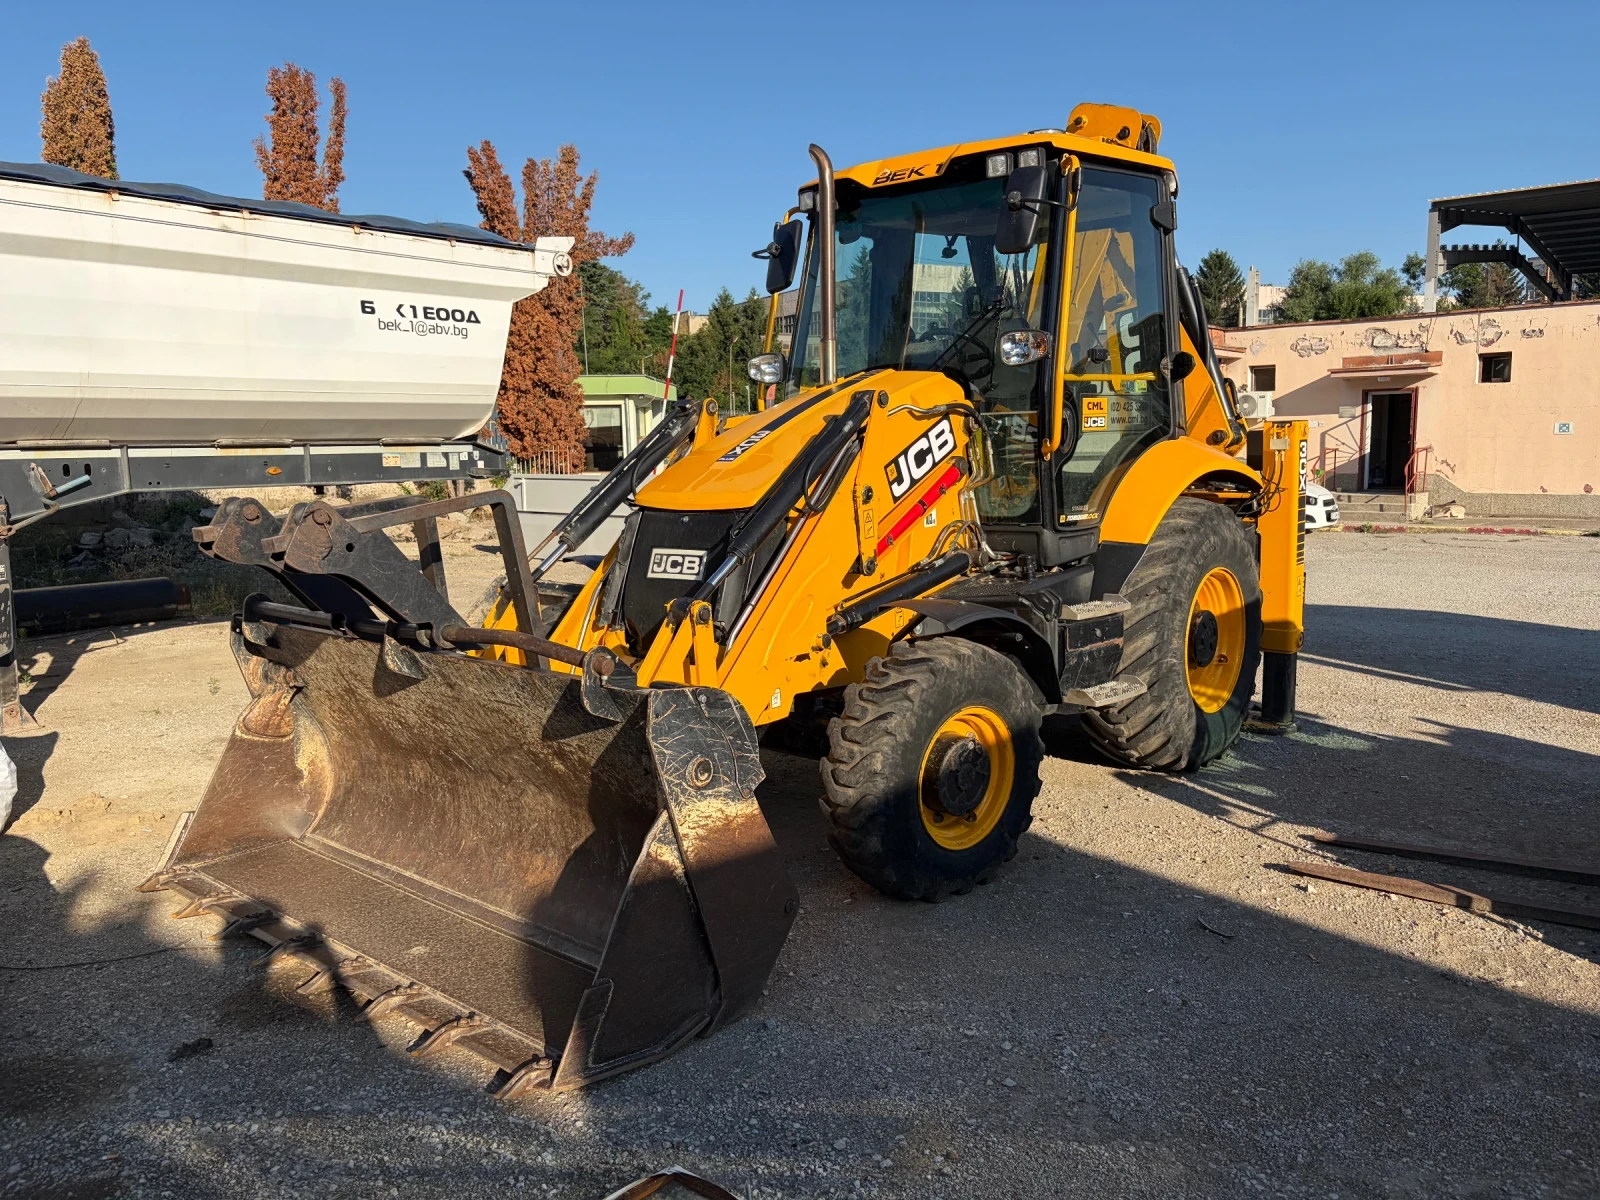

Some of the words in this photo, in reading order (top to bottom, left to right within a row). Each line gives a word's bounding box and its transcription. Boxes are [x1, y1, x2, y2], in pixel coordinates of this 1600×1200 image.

[378, 317, 468, 339] bek_1@abv.bg
[1086, 401, 1104, 411] CML
[1084, 416, 1105, 428] JCB
[890, 418, 956, 498] JCB
[1299, 440, 1307, 491] 3CX
[651, 554, 701, 575] JCB
